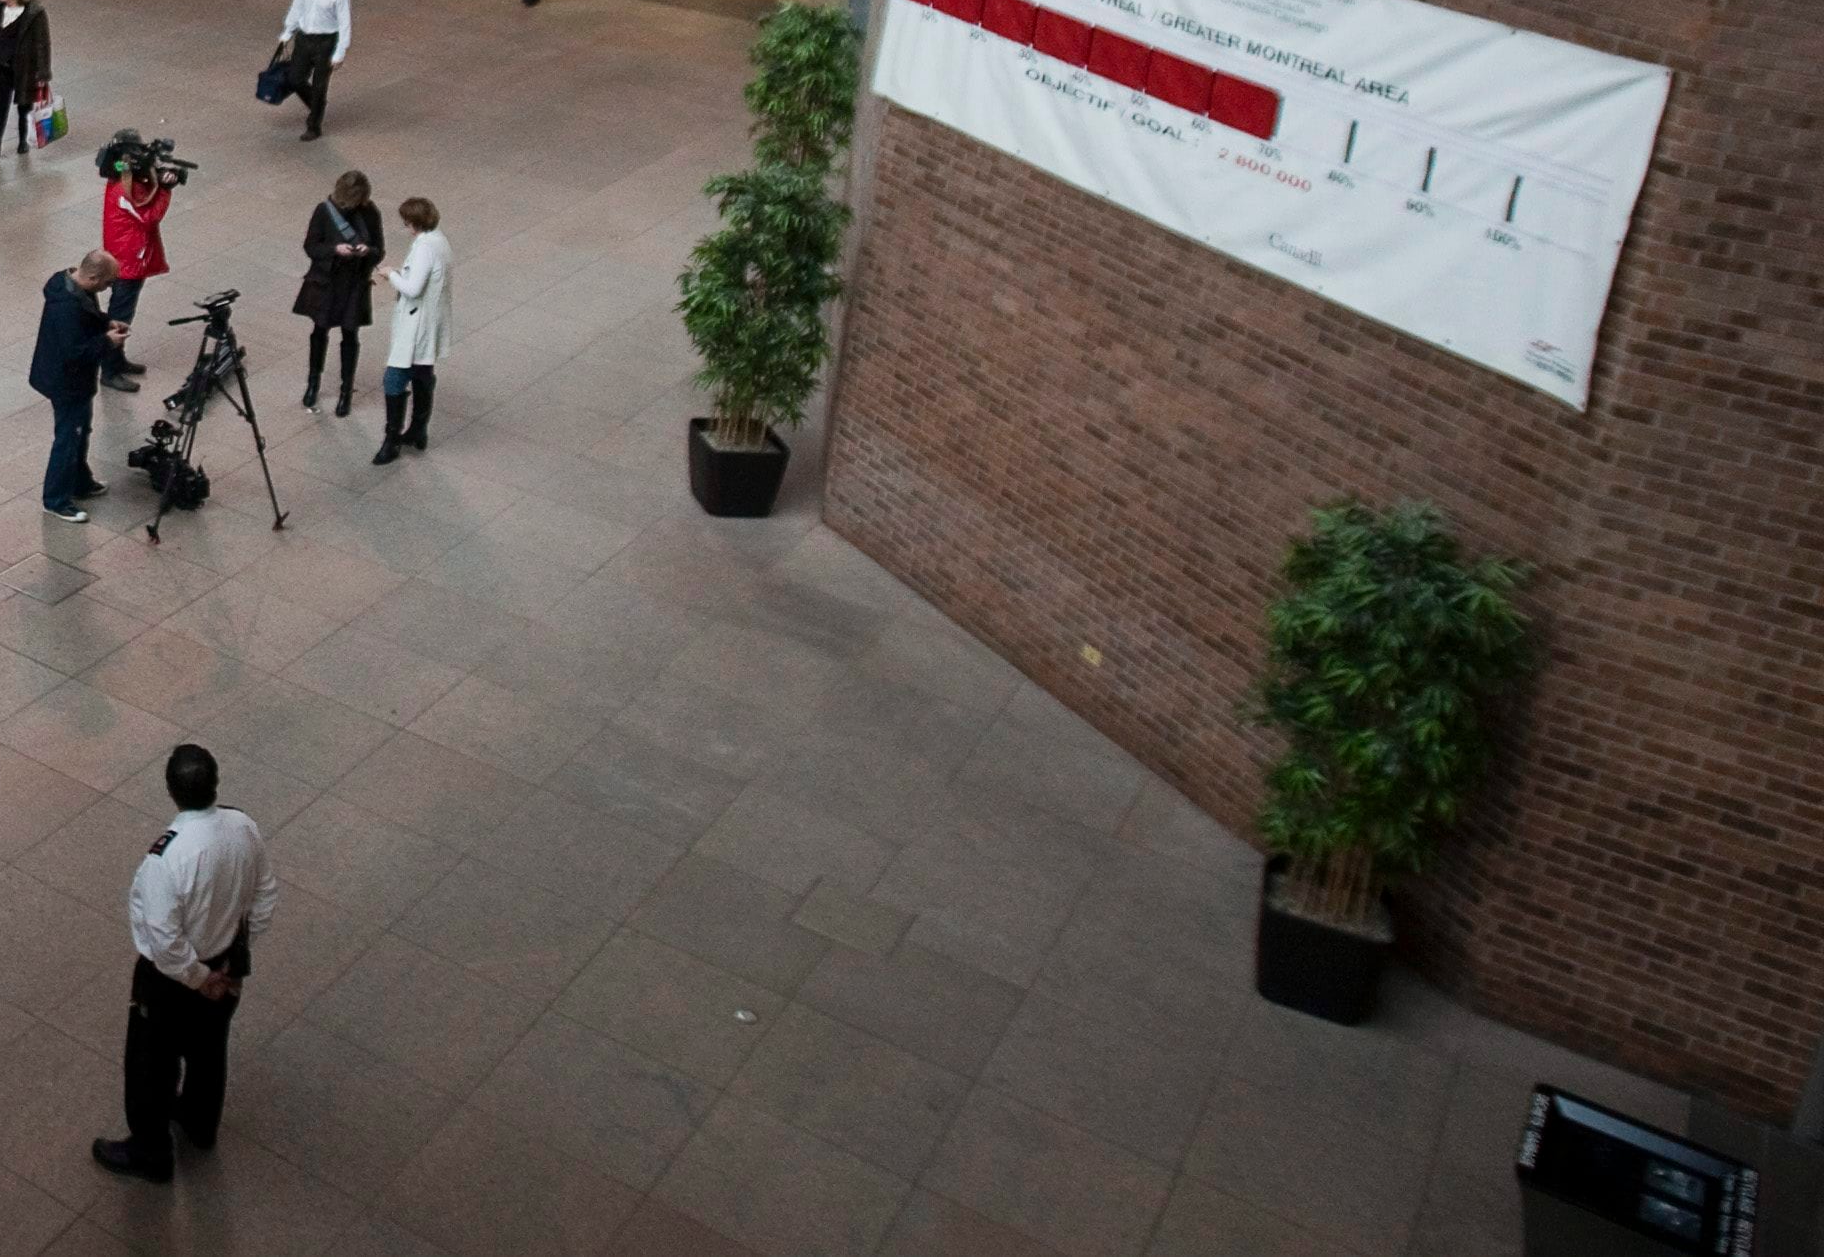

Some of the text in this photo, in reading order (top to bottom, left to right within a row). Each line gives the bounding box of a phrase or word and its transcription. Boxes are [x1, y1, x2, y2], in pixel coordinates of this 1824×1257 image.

[1161, 11, 1242, 50] GREATER
[1246, 40, 1351, 87] MONTREAL
[1354, 76, 1410, 105] AREA
[1025, 68, 1115, 111] OBJECTIF
[1131, 112, 1187, 143] GOAL
